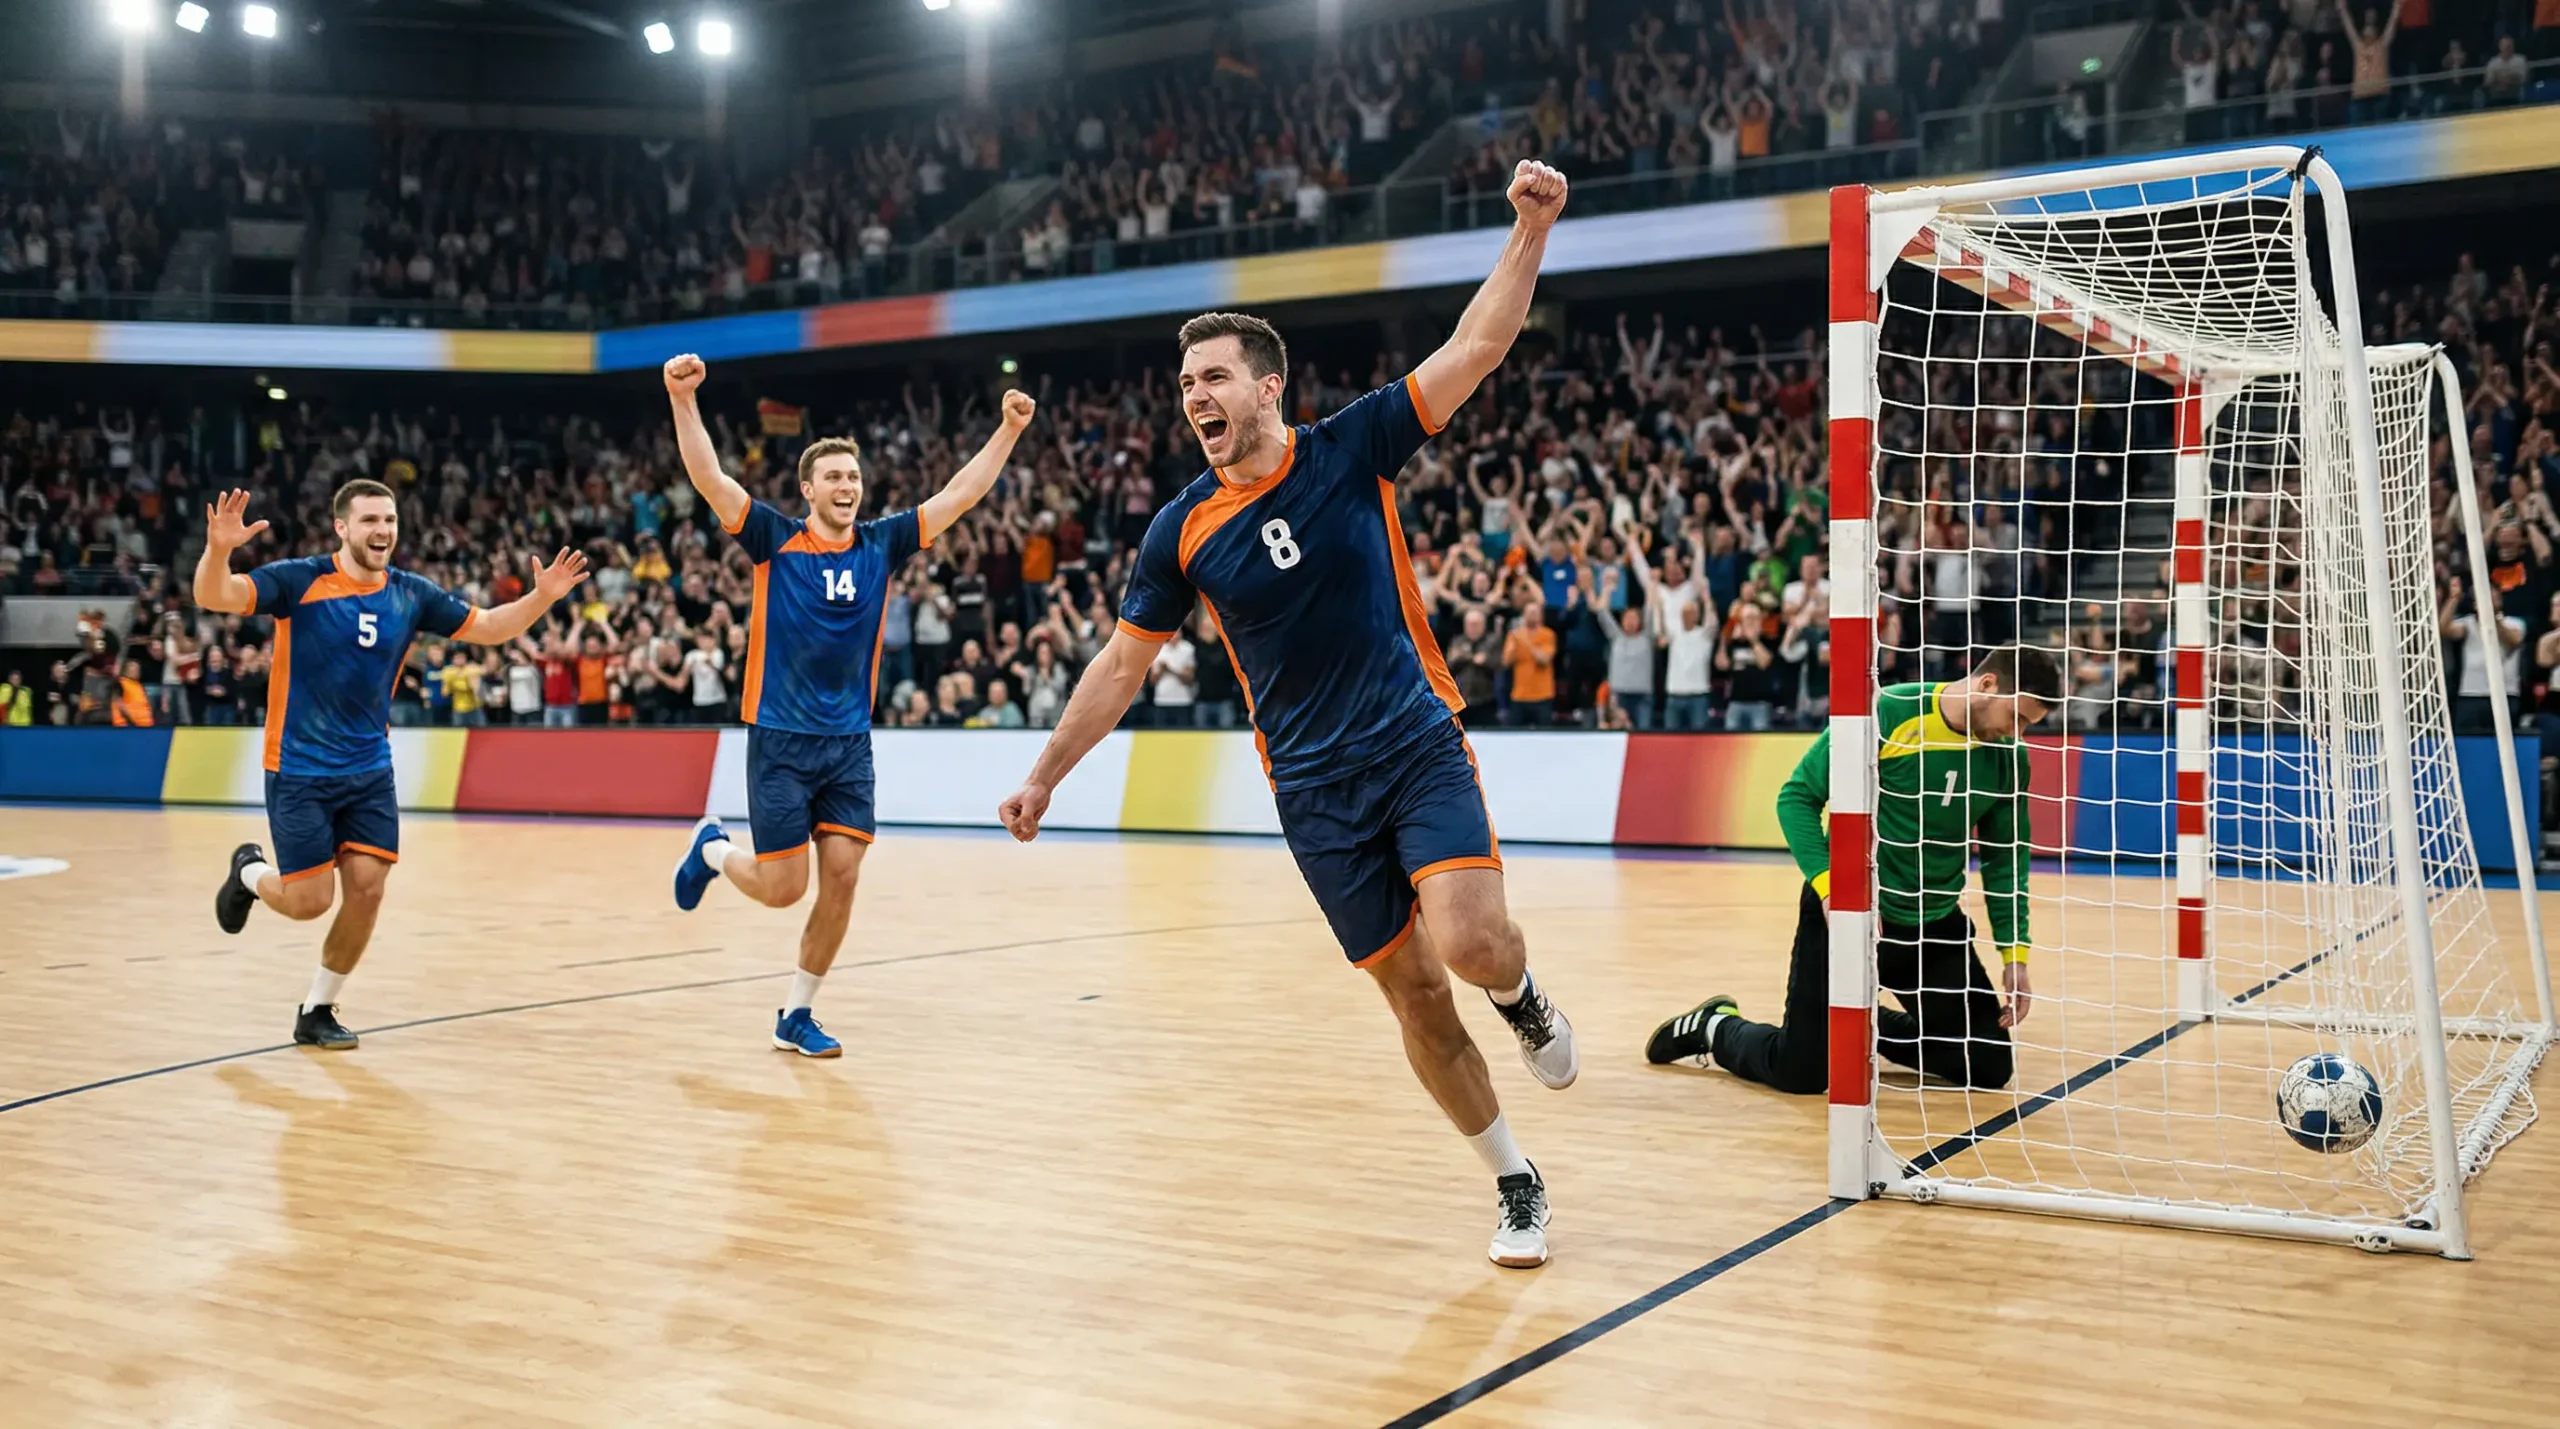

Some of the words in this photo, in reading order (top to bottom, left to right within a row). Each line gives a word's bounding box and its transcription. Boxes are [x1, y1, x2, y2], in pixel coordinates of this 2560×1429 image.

[1261, 518, 1301, 570] 8
[822, 569, 857, 601] 14
[358, 613, 378, 648] 5
[1941, 770, 1958, 807] 1
